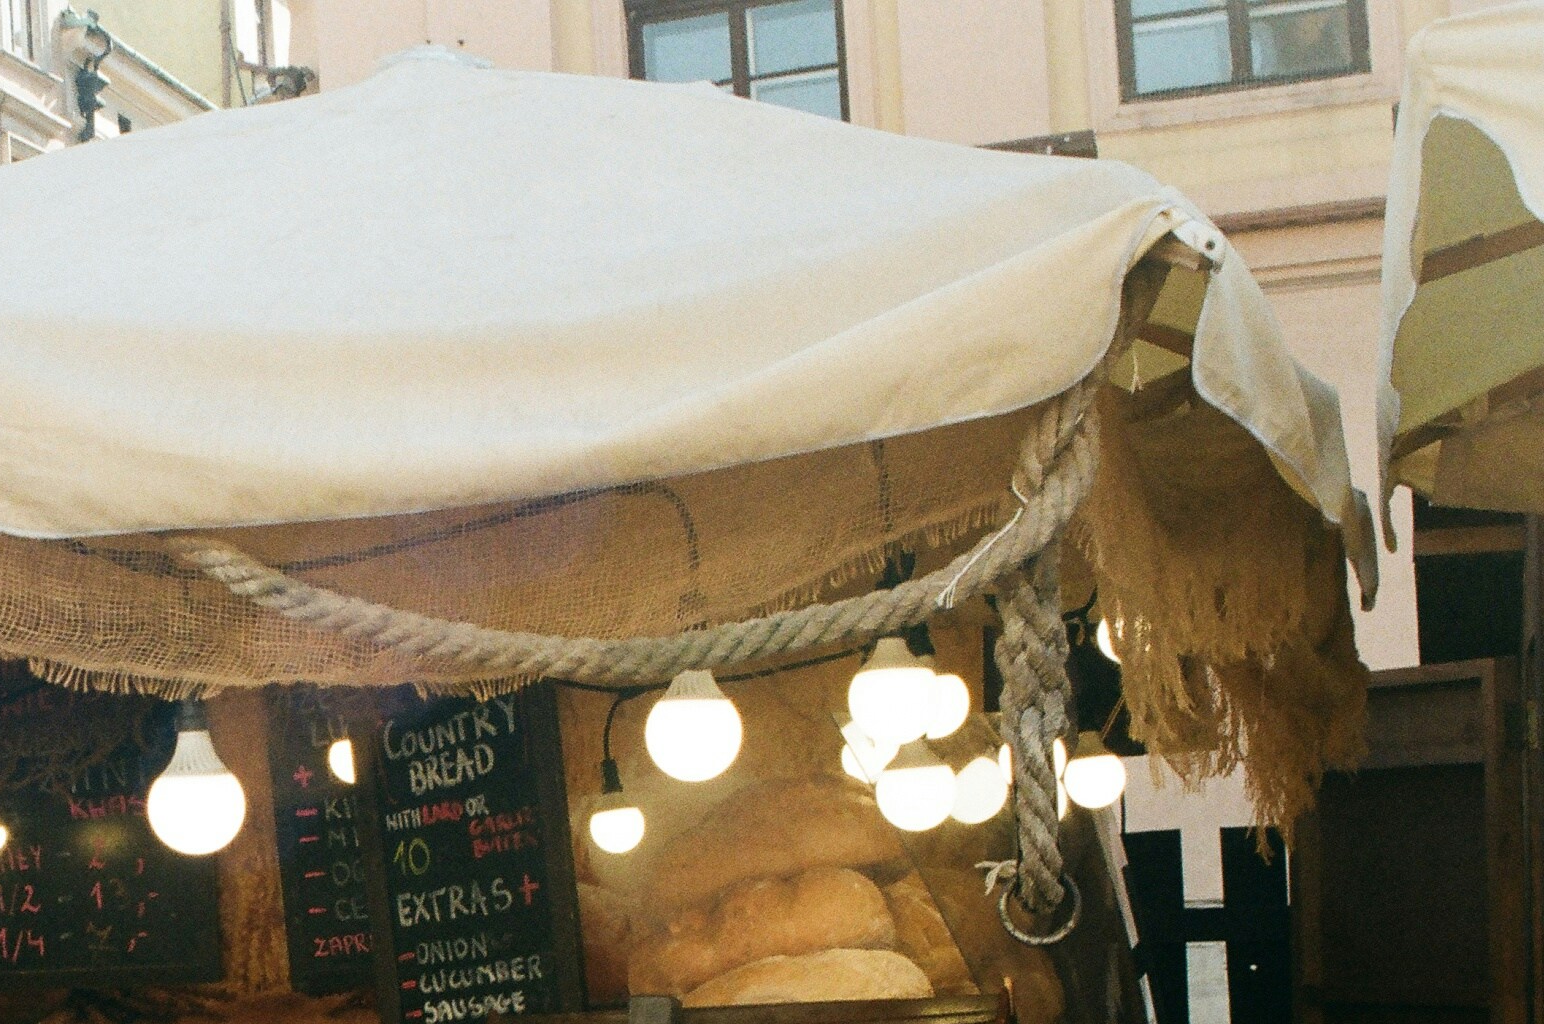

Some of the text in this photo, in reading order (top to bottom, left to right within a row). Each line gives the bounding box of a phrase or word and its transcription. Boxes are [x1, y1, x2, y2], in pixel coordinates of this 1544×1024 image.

[383, 699, 516, 761] COUNTRY
[409, 744, 494, 796] BREAD
[386, 807, 421, 831] WITH
[465, 794, 489, 816] OR
[393, 838, 430, 876] 10
[398, 876, 513, 927] EXTRAS
[416, 932, 488, 967] ONION
[419, 954, 542, 994] CUCUMBER
[424, 990, 525, 1024] SAUSAGE
